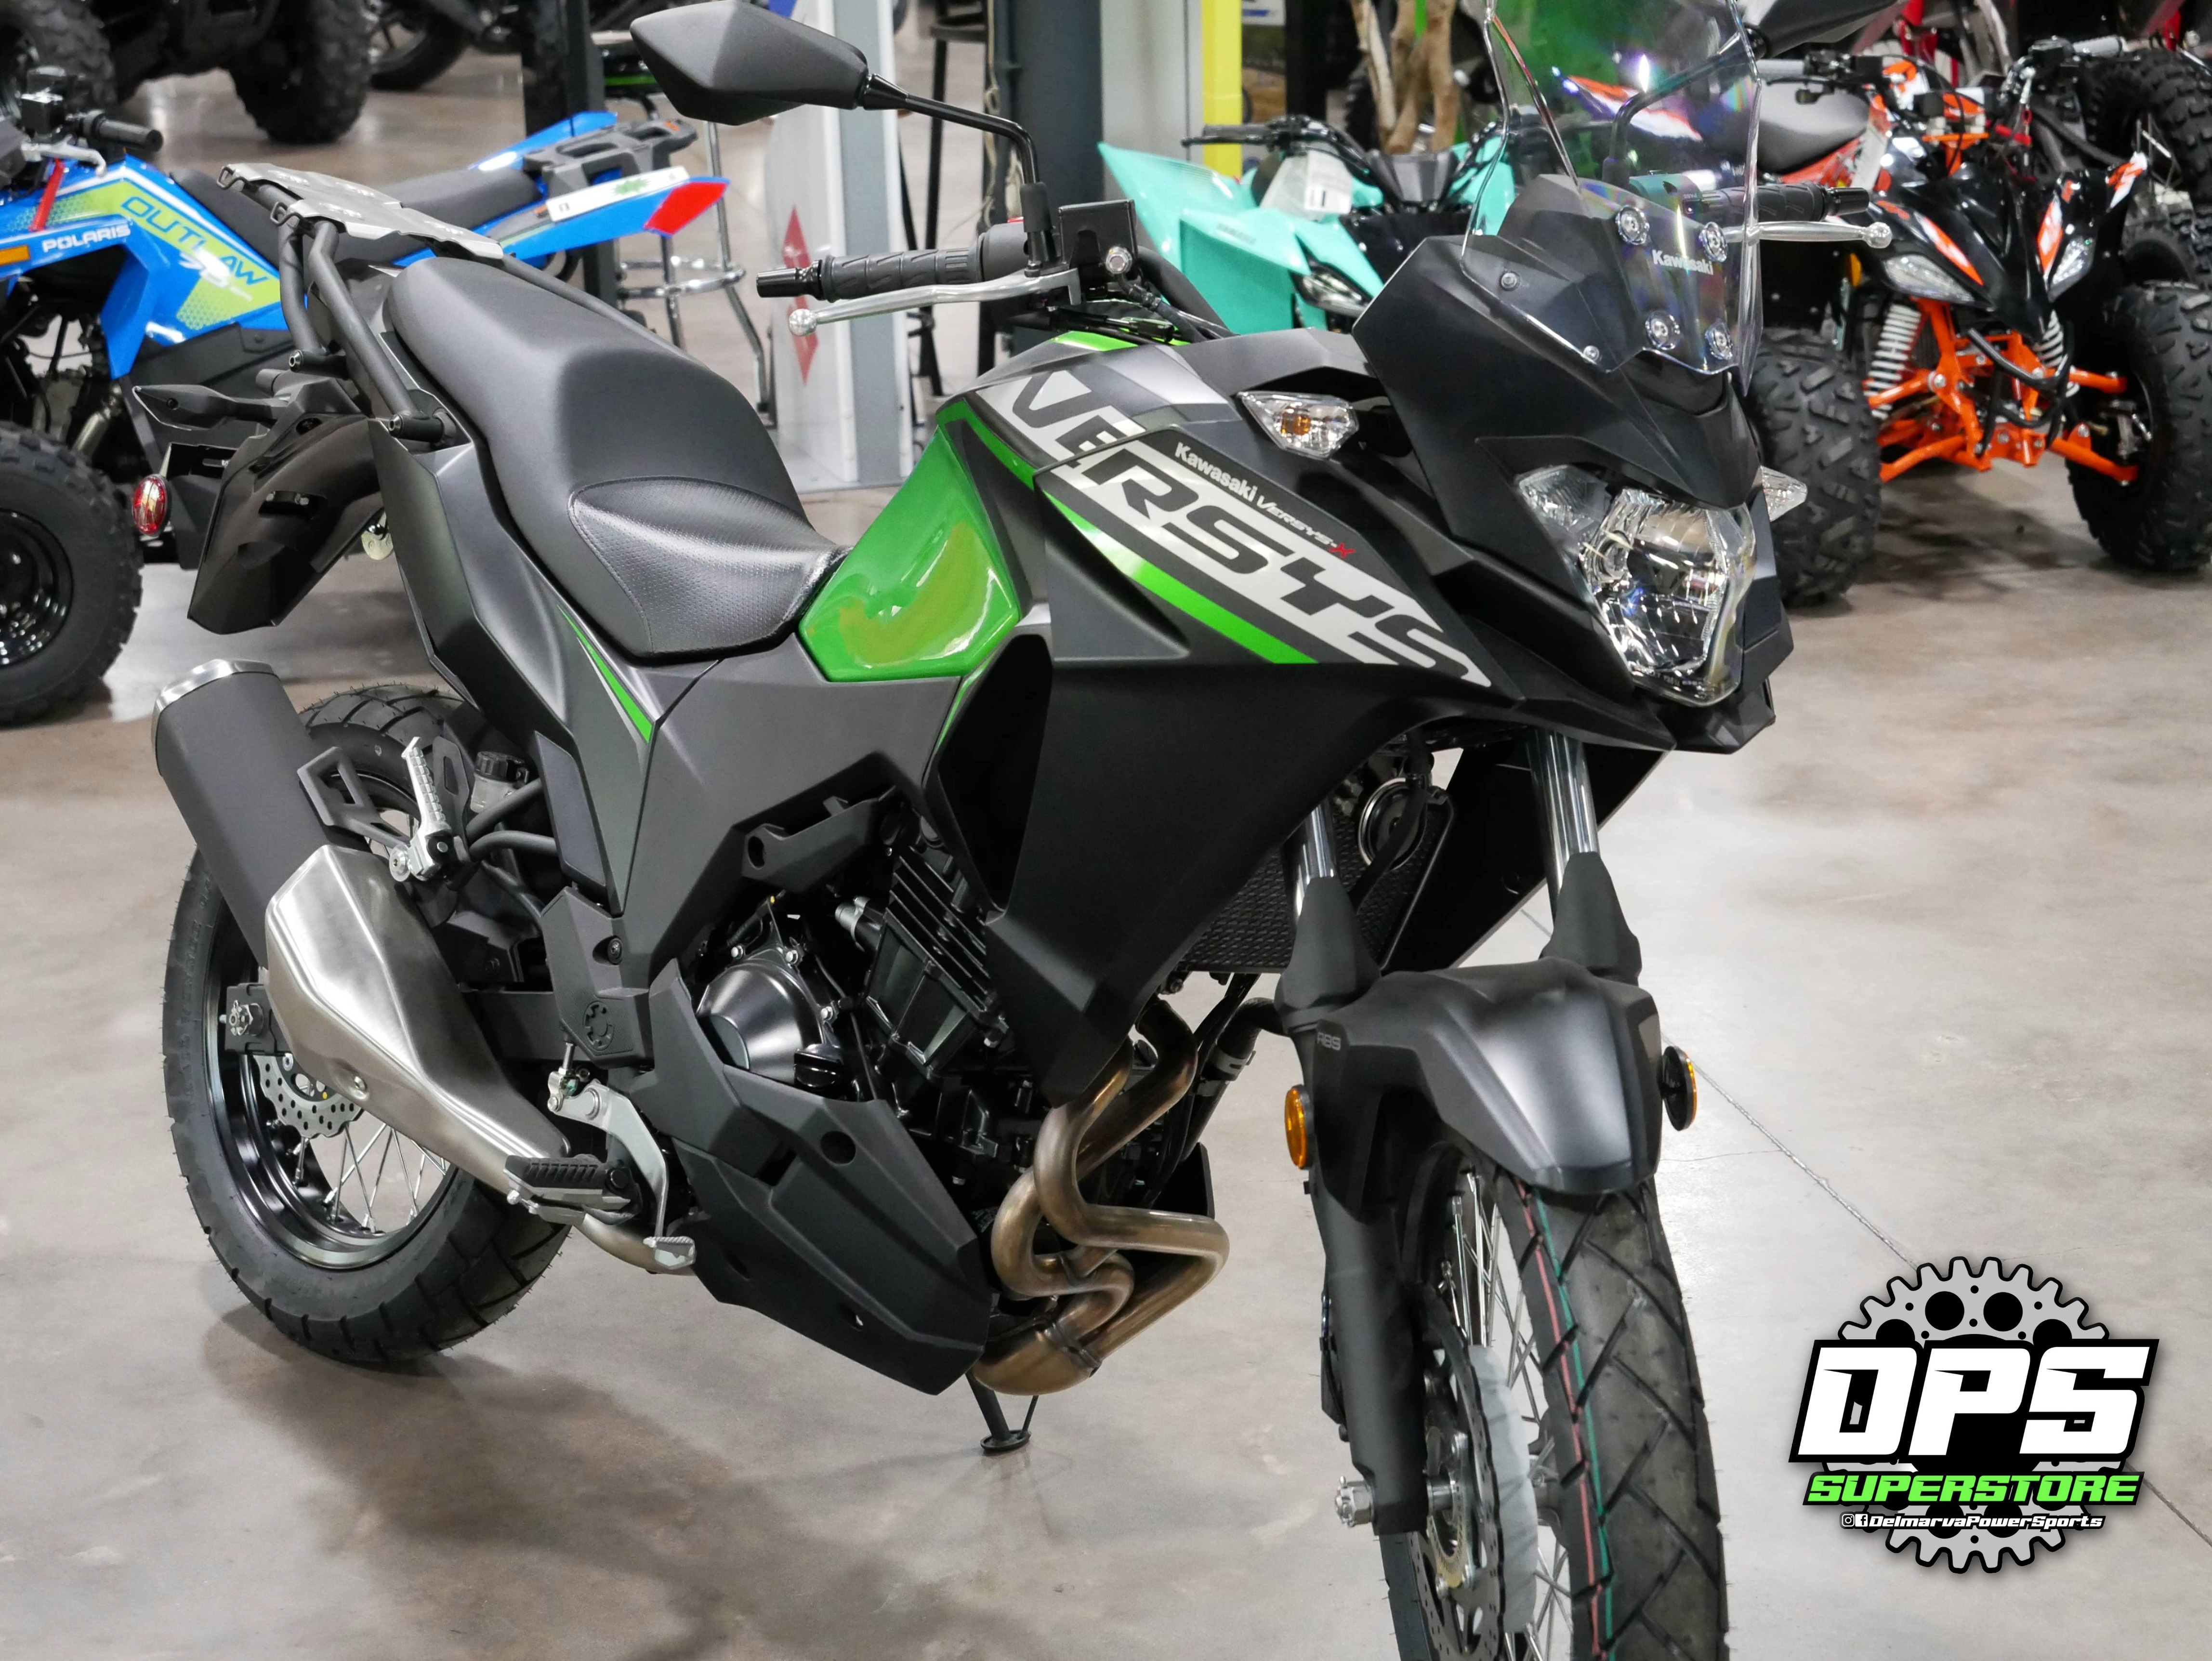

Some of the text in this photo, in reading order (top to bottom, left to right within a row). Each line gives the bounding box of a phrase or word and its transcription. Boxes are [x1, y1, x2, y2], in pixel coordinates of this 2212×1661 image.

[42, 225, 132, 253] POLARIS
[1174, 442, 1258, 502] Kawasaki
[1012, 370, 1470, 680] VERSYS
[1317, 1032, 1342, 1051] ABS
